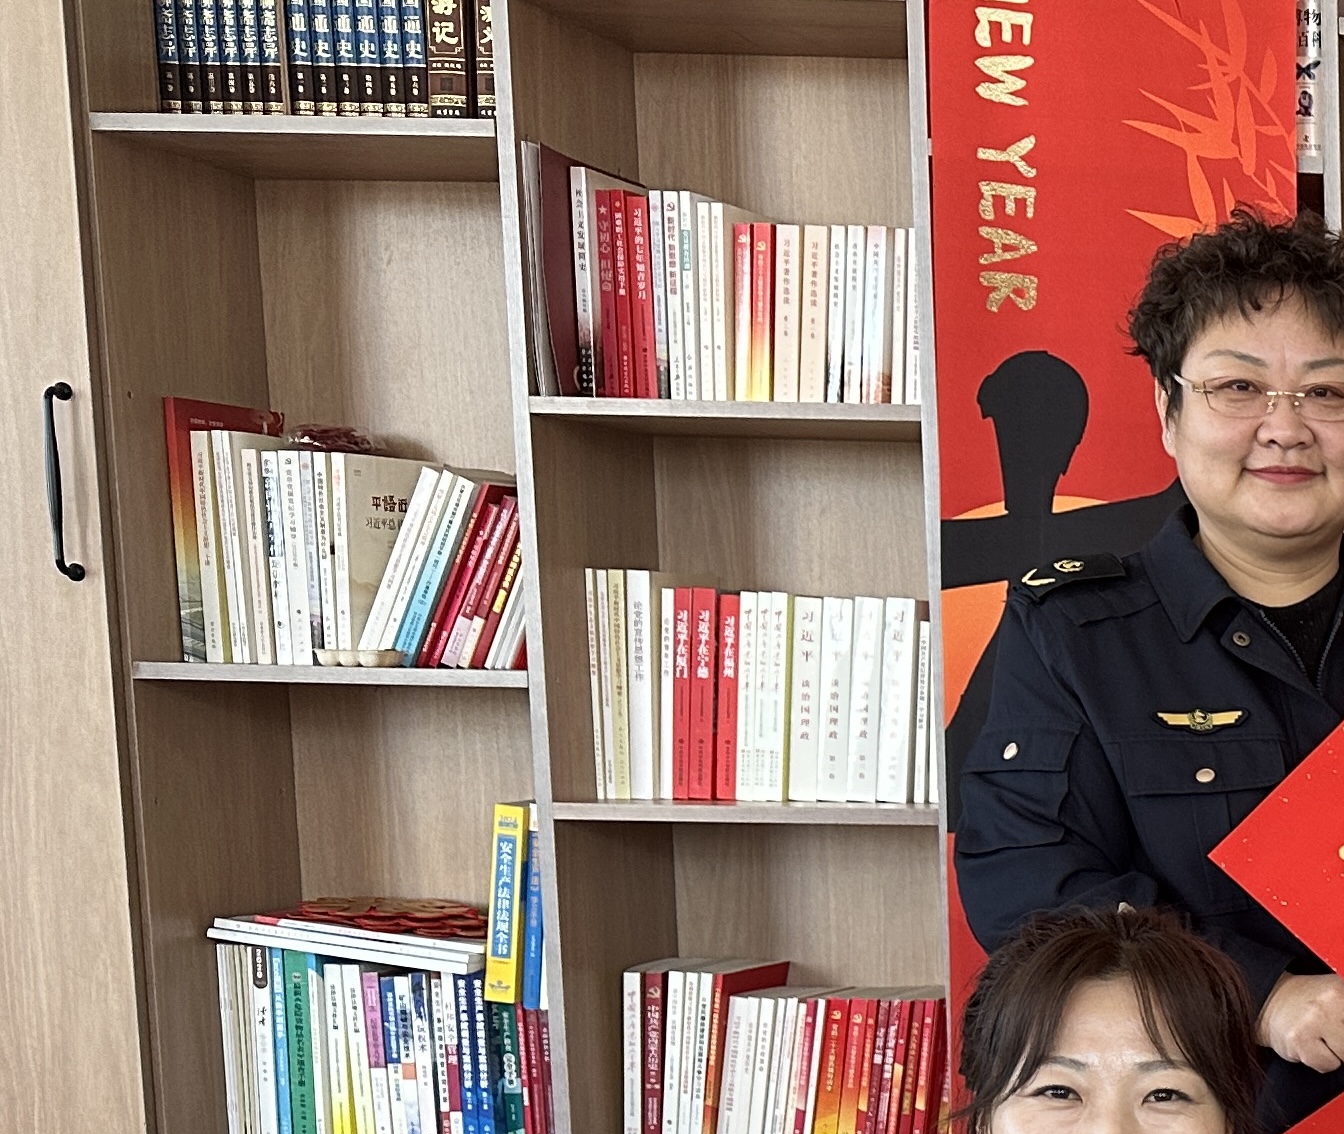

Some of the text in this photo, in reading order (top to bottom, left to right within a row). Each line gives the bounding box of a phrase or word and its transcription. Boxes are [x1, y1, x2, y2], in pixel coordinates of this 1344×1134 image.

[974, 0, 1038, 313] EW YEAR
[633, 208, 647, 300] 习近平的七年知青岁月
[666, 216, 677, 241] 新时代
[667, 243, 678, 268] 新思想
[783, 239, 791, 305] 习近平著作选读
[810, 241, 818, 308] 习近平著作选读
[632, 600, 645, 682] 论党的宣传思想工作
[675, 609, 689, 680] 习近平在厦门
[696, 609, 710, 680] 习近平在宁德
[723, 615, 735, 679] 习近平在福州
[799, 611, 814, 741] 习近平 谈治国理政
[828, 678, 840, 740] 谈治国理政
[496, 840, 515, 956] 安全生产法律法规全书
